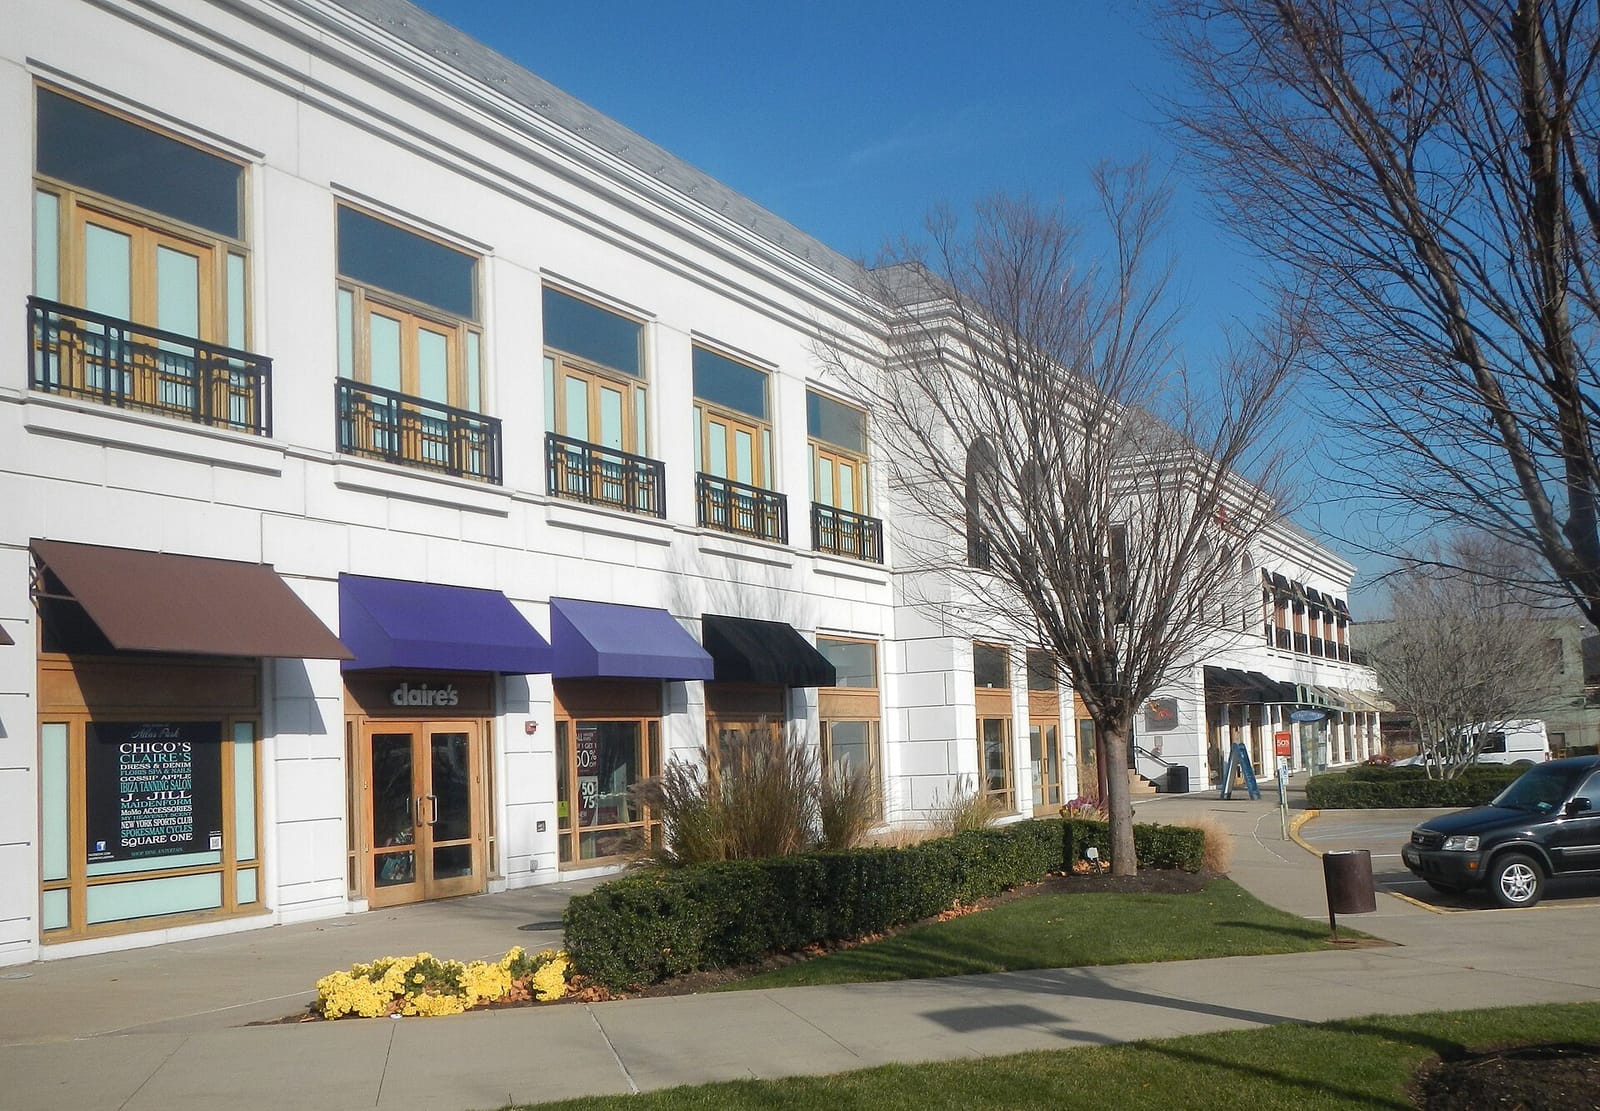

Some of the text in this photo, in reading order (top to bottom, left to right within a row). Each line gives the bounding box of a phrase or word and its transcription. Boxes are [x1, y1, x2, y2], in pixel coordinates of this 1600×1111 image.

[393, 682, 458, 706] claire's
[119, 742, 192, 754] CHICO'S
[119, 753, 192, 764] CLAIRE'S
[120, 779, 192, 793] IBIZA TANNING SALON
[120, 790, 192, 803] J. JILL
[120, 798, 192, 809] MAIDENFORM
[143, 805, 193, 815] ACCESSORIES
[120, 816, 193, 829] NEW YORK SPORTS CLUB
[121, 824, 193, 838] SPOKESMAN CYCLES
[121, 832, 193, 848] SQUARE ONE
